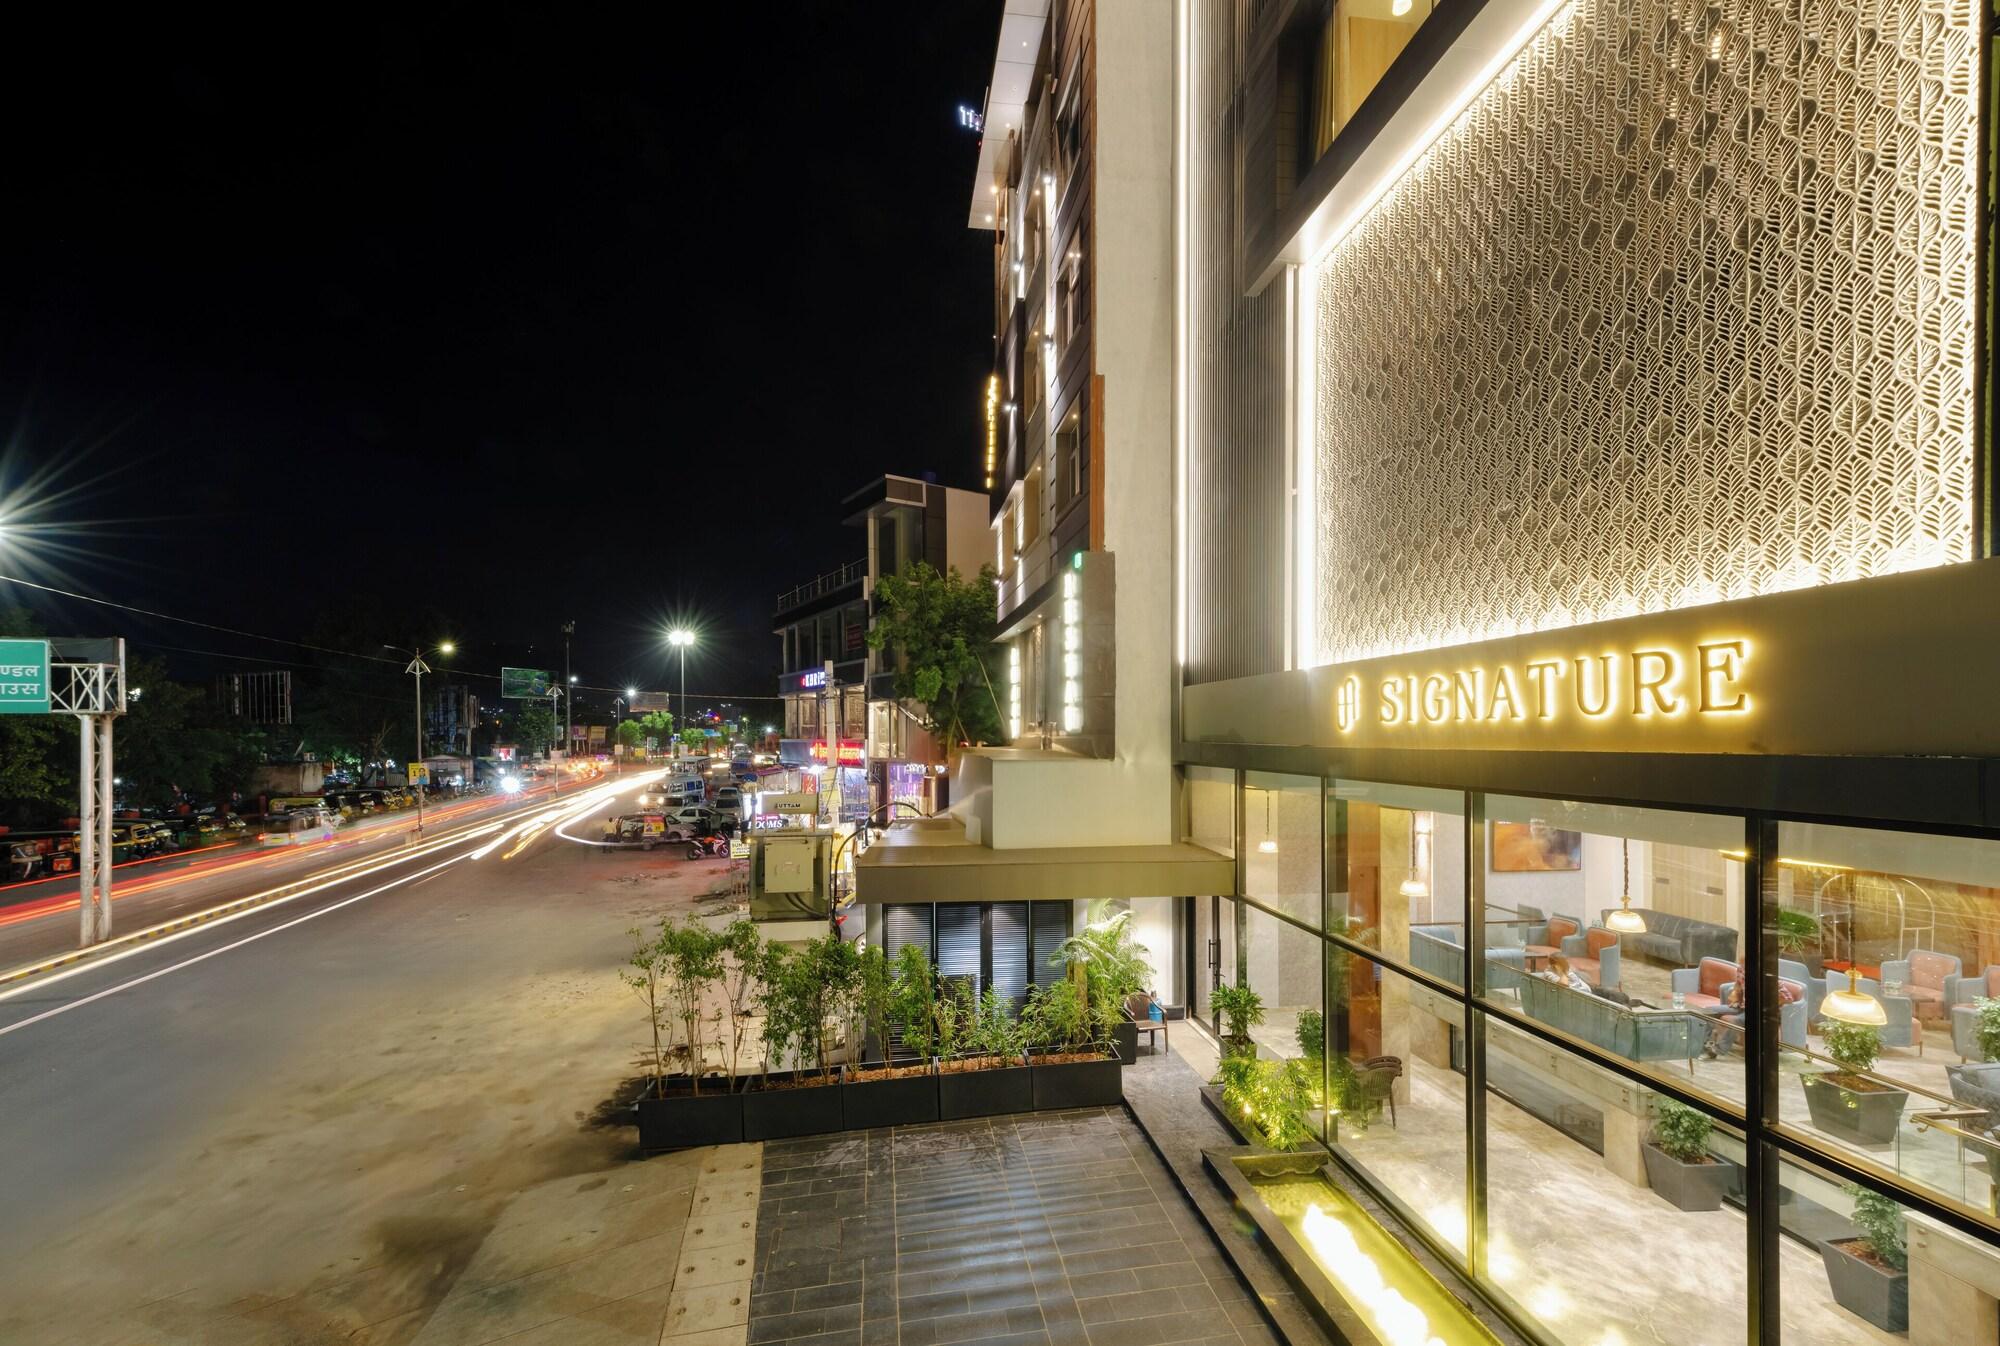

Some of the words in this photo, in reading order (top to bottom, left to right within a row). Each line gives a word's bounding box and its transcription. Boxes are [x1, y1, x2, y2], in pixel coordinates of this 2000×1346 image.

[0, 665, 40, 677] ण्डल
[1379, 640, 1749, 725] SIGNATURE
[0, 683, 40, 695] ाउस
